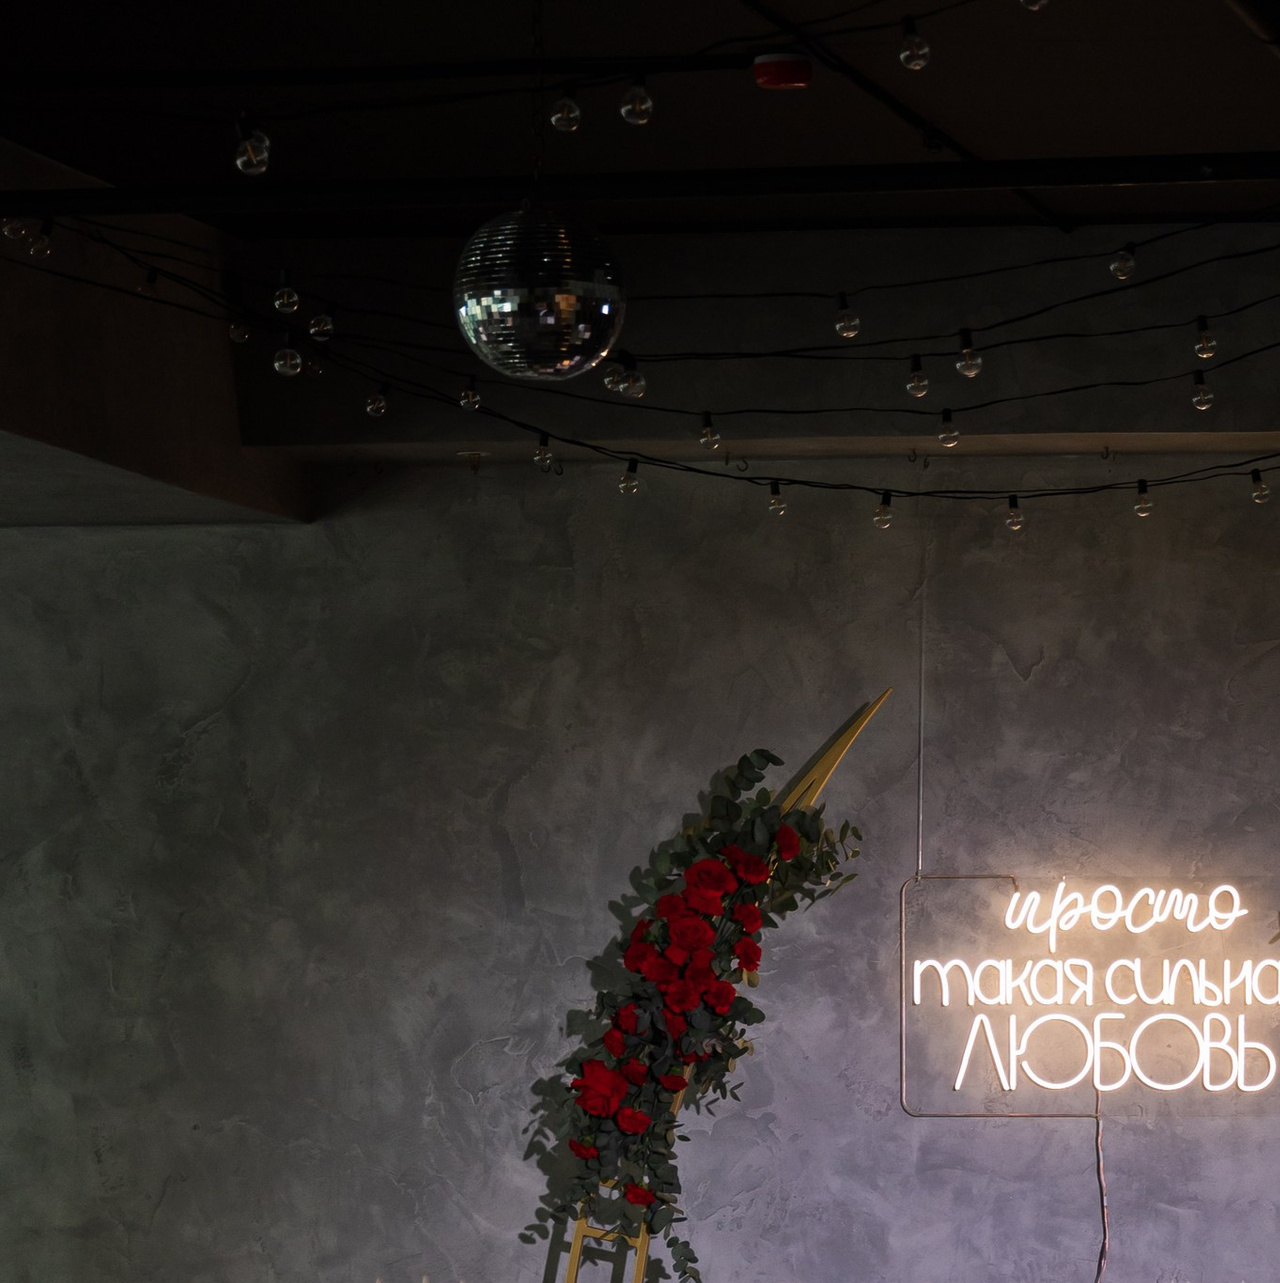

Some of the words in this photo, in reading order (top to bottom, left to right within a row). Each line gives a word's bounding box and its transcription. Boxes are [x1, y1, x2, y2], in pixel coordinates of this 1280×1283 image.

[1005, 877, 1248, 953] просто
[913, 958, 1093, 1006] такая
[954, 1013, 1277, 1091] ЛЮБОВЬ
